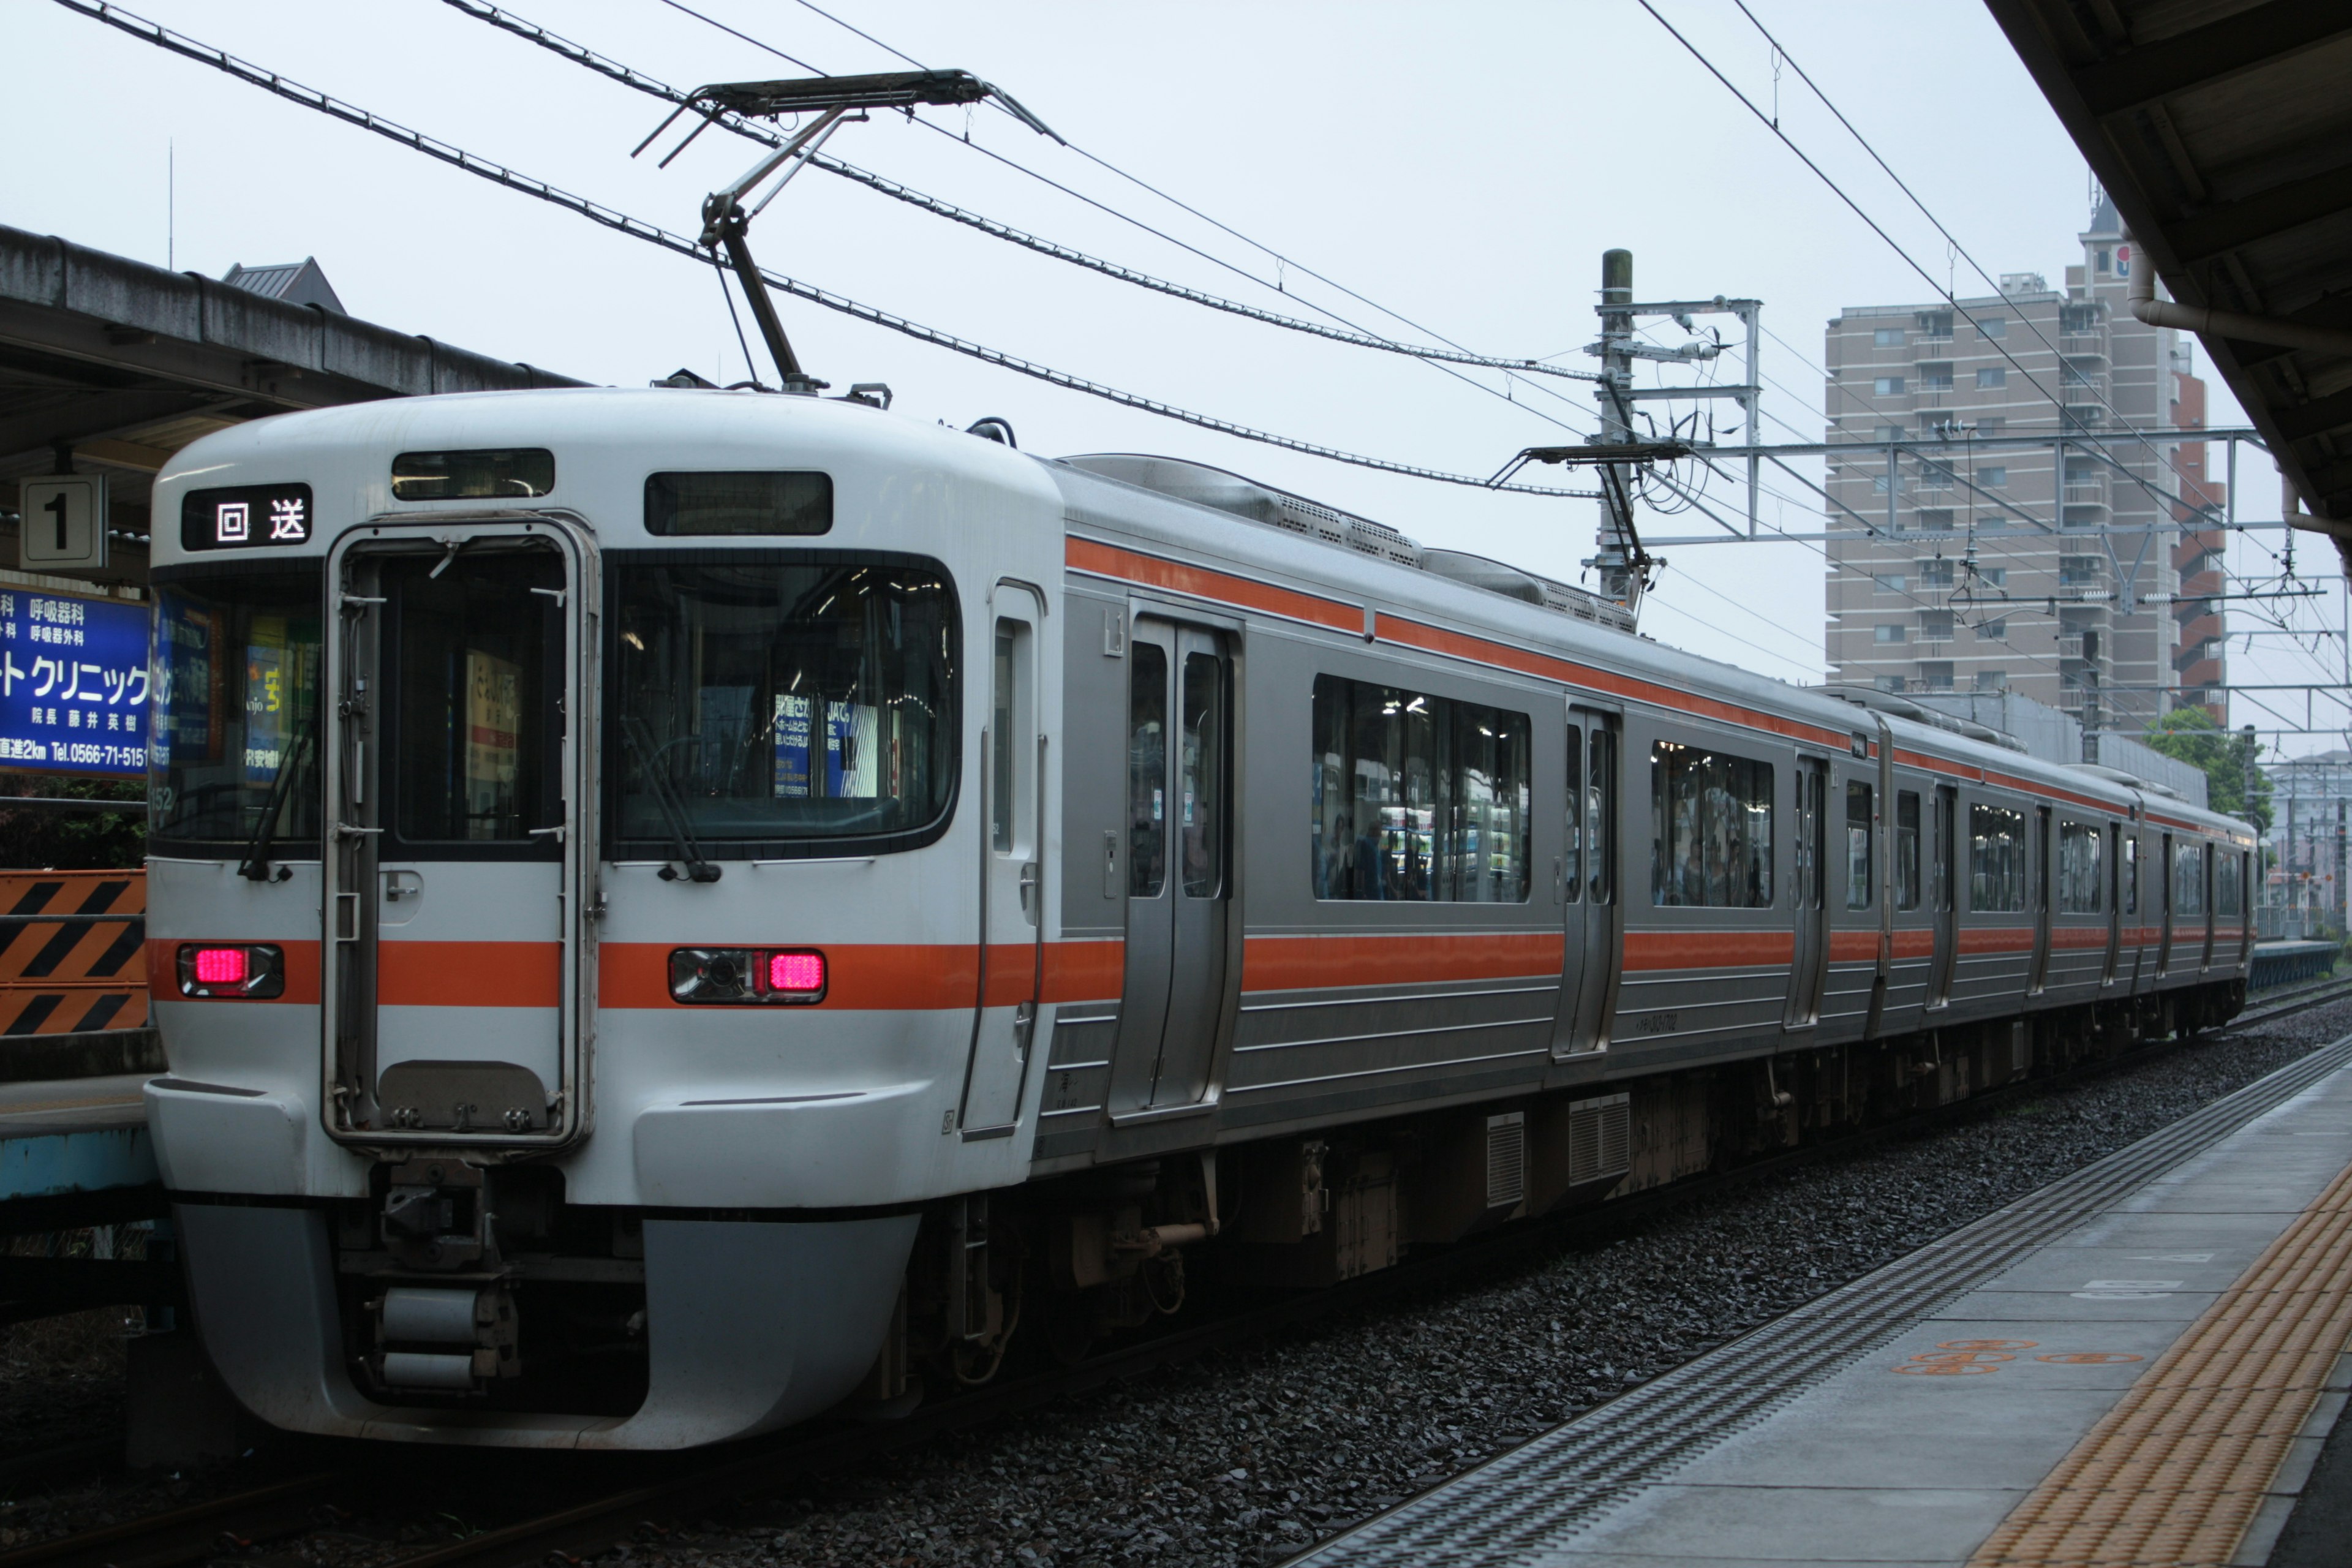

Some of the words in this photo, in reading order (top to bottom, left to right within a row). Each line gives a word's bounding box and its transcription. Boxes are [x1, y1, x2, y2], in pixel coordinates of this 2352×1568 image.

[44, 492, 67, 550] 1
[216, 498, 306, 542] 回送
[1, 594, 14, 617] 科
[30, 598, 85, 626] 呼吸器科
[31, 625, 85, 646] 呼吸器外科
[0, 650, 149, 705] トクリニック
[32, 707, 57, 725] 院長
[69, 709, 99, 729] 藤井
[108, 713, 137, 732] 英樹
[0, 737, 47, 760] 直進2km
